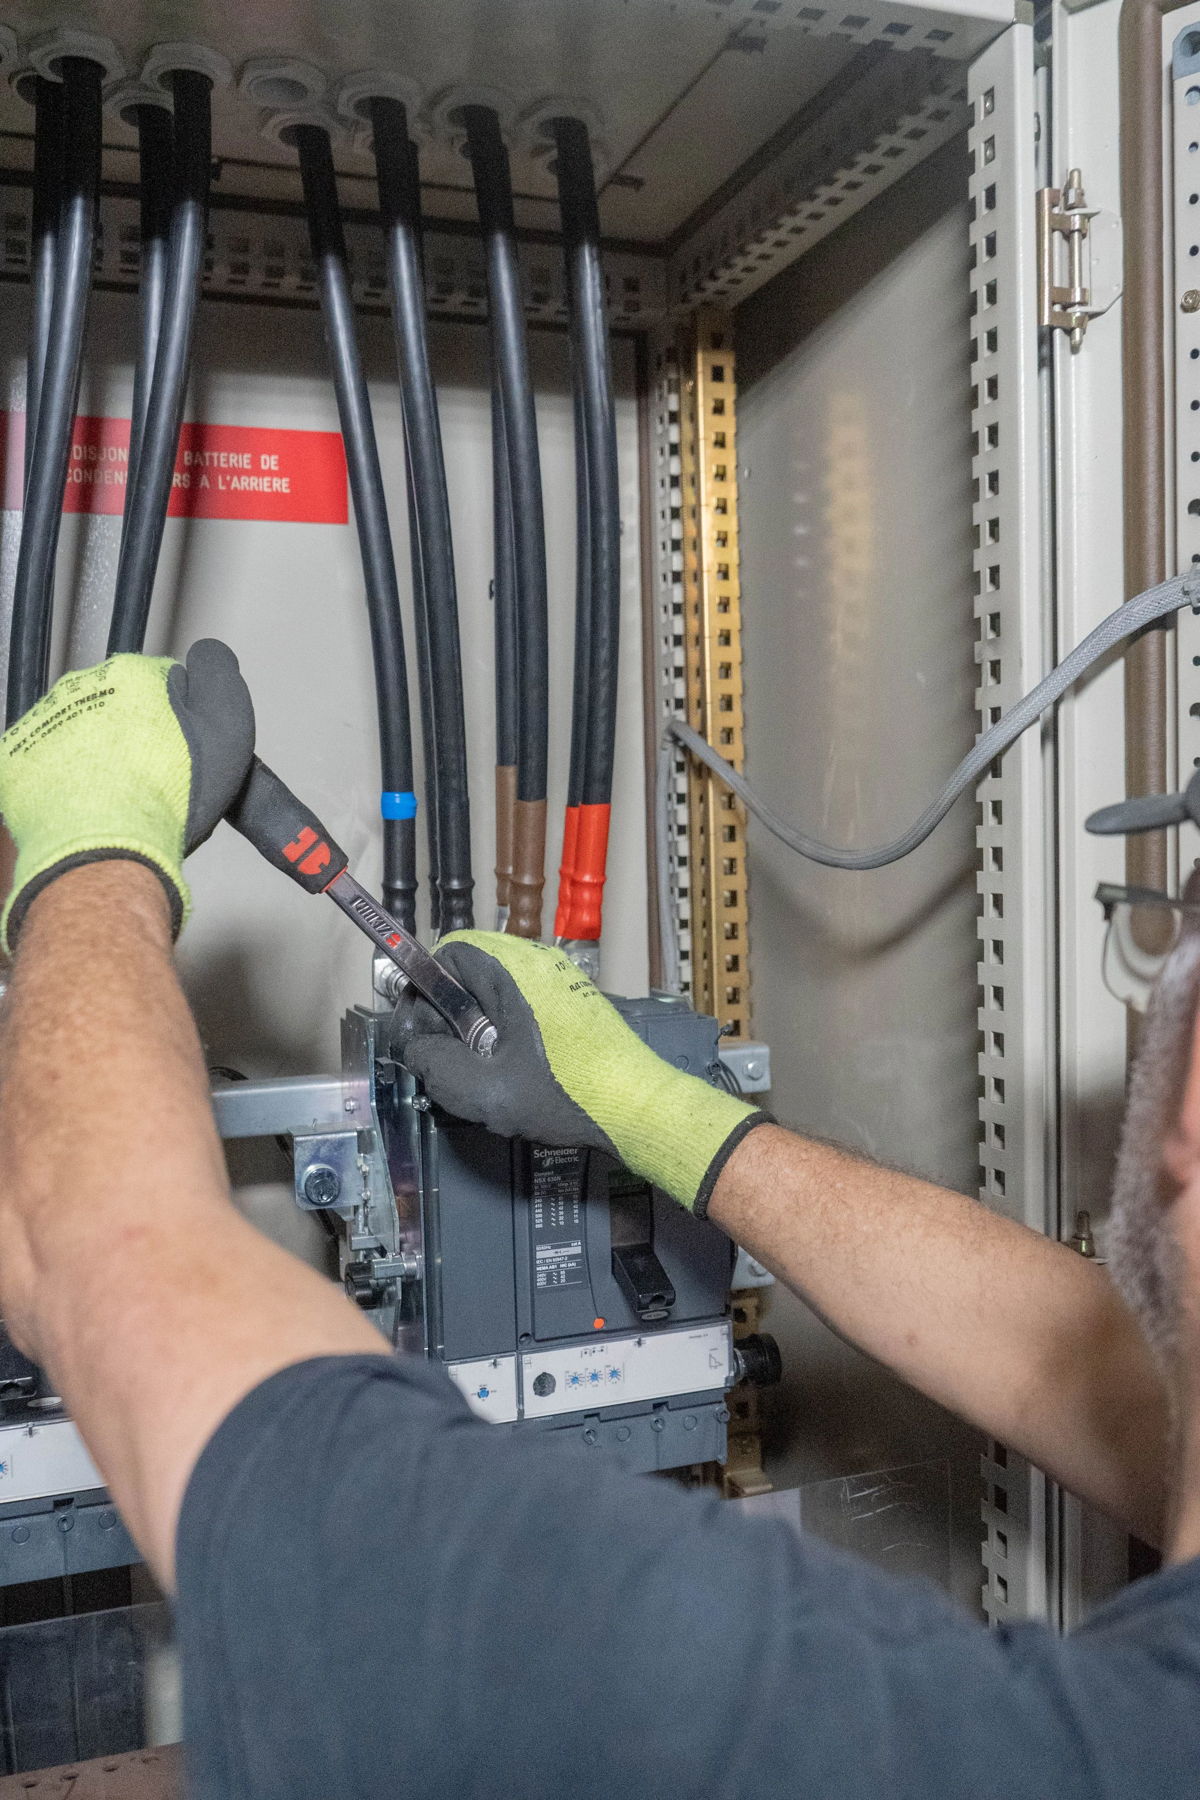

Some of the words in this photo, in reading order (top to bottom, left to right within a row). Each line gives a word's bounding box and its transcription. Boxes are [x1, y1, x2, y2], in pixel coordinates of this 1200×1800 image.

[73, 445, 129, 462] DISJON
[183, 451, 252, 469] BATTERIE
[260, 454, 279, 471] DE
[199, 473, 210, 489] A
[218, 475, 291, 493] L'ARRIERE
[30, 704, 72, 737] COMFORT
[74, 687, 115, 707] THERMO
[533, 1148, 578, 1158] Schneider
[554, 1156, 580, 1164] Electric
